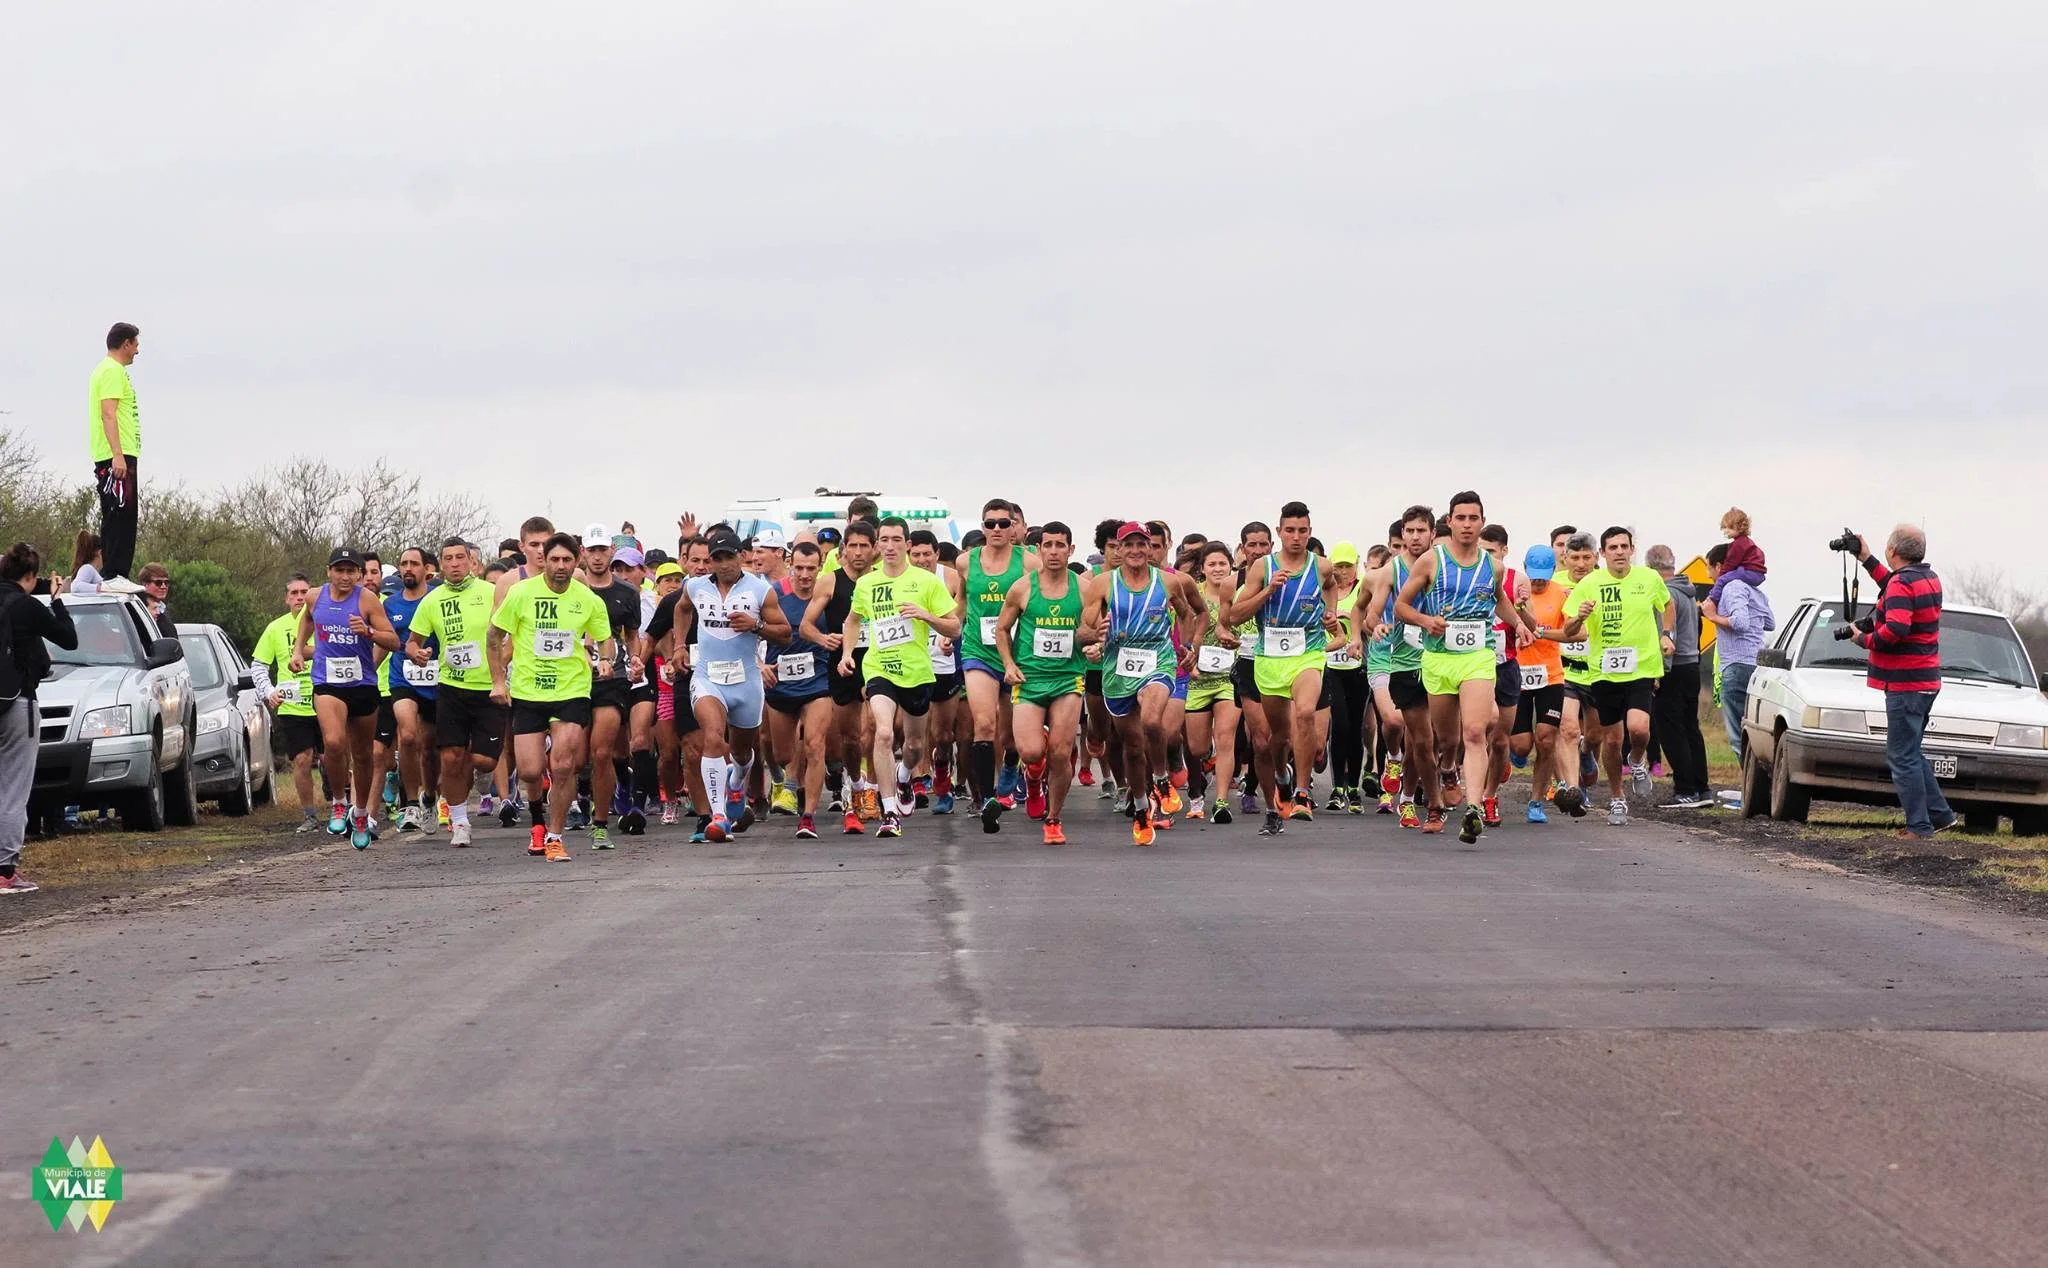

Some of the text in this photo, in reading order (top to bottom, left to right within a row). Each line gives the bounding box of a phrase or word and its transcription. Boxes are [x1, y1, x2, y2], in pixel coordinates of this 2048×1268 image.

[980, 593, 1006, 602] PABL
[699, 603, 751, 611] BELEN
[1035, 617, 1075, 626] MARTIN
[320, 632, 359, 645] ASSI
[878, 625, 910, 644] 121
[1455, 632, 1476, 646] 68
[543, 640, 564, 652] 54
[1042, 640, 1063, 653] 91
[1279, 638, 1290, 651] 6
[1566, 641, 1585, 652] 35
[452, 652, 472, 666] 34
[1211, 656, 1220, 668] 2
[1610, 656, 1628, 669] 37
[786, 663, 806, 676] 15
[1125, 659, 1146, 672] 67
[335, 667, 354, 679] 56
[407, 669, 435, 681] 116
[721, 671, 731, 683] 7
[1520, 674, 1543, 686] 07
[1934, 760, 1955, 774] 885
